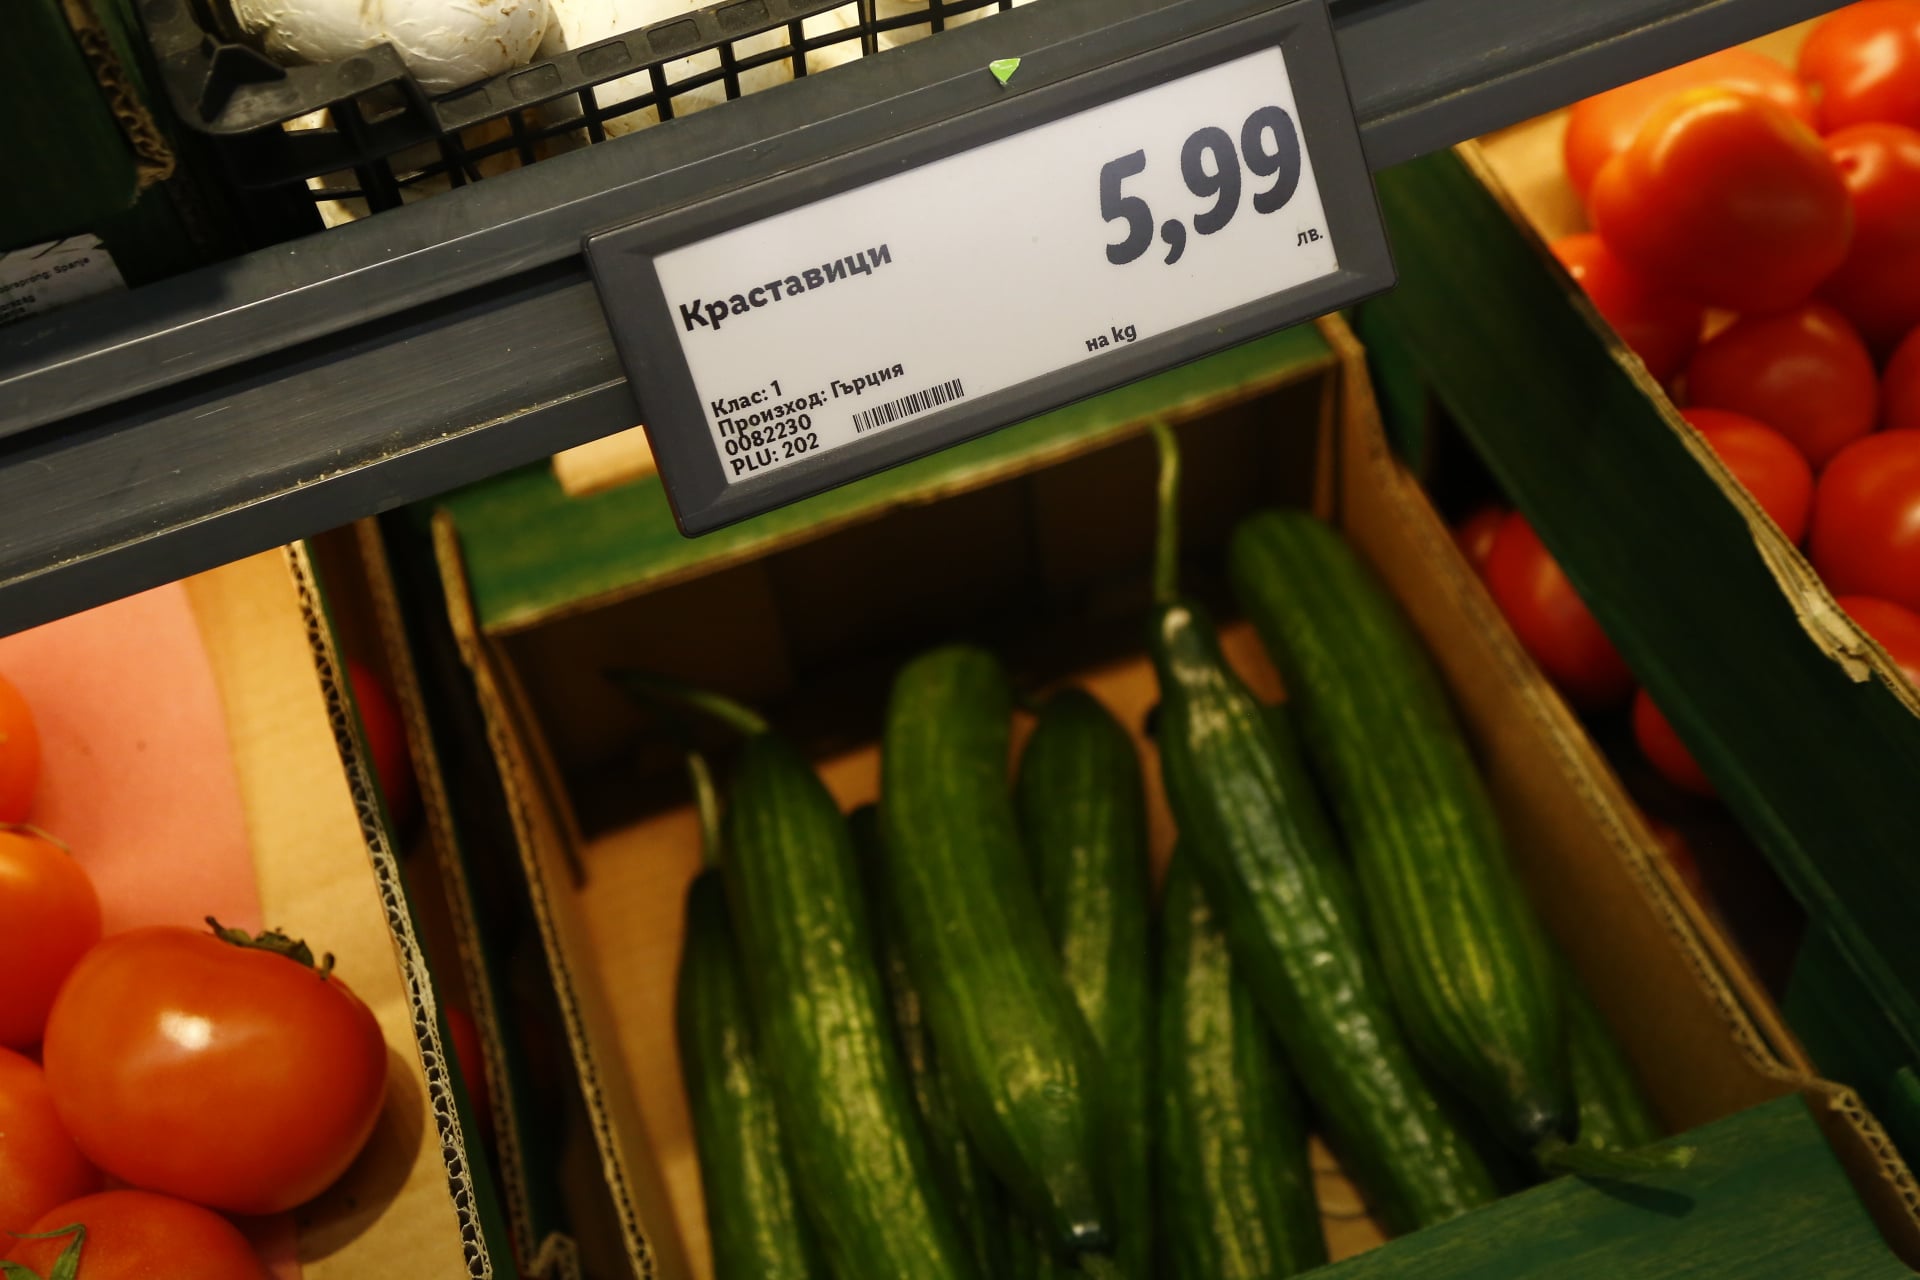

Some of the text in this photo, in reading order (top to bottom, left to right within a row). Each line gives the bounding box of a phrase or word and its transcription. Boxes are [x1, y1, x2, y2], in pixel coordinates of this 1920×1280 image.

[1100, 105, 1301, 265] 5,99
[1297, 228, 1324, 247] лв.
[679, 243, 892, 332] Краставици
[1086, 324, 1137, 352] на kg
[710, 379, 782, 418] Клас: 1
[718, 363, 905, 438] Произход: Гърция
[724, 413, 812, 456] 0082230
[729, 432, 820, 476] PLU: 202
